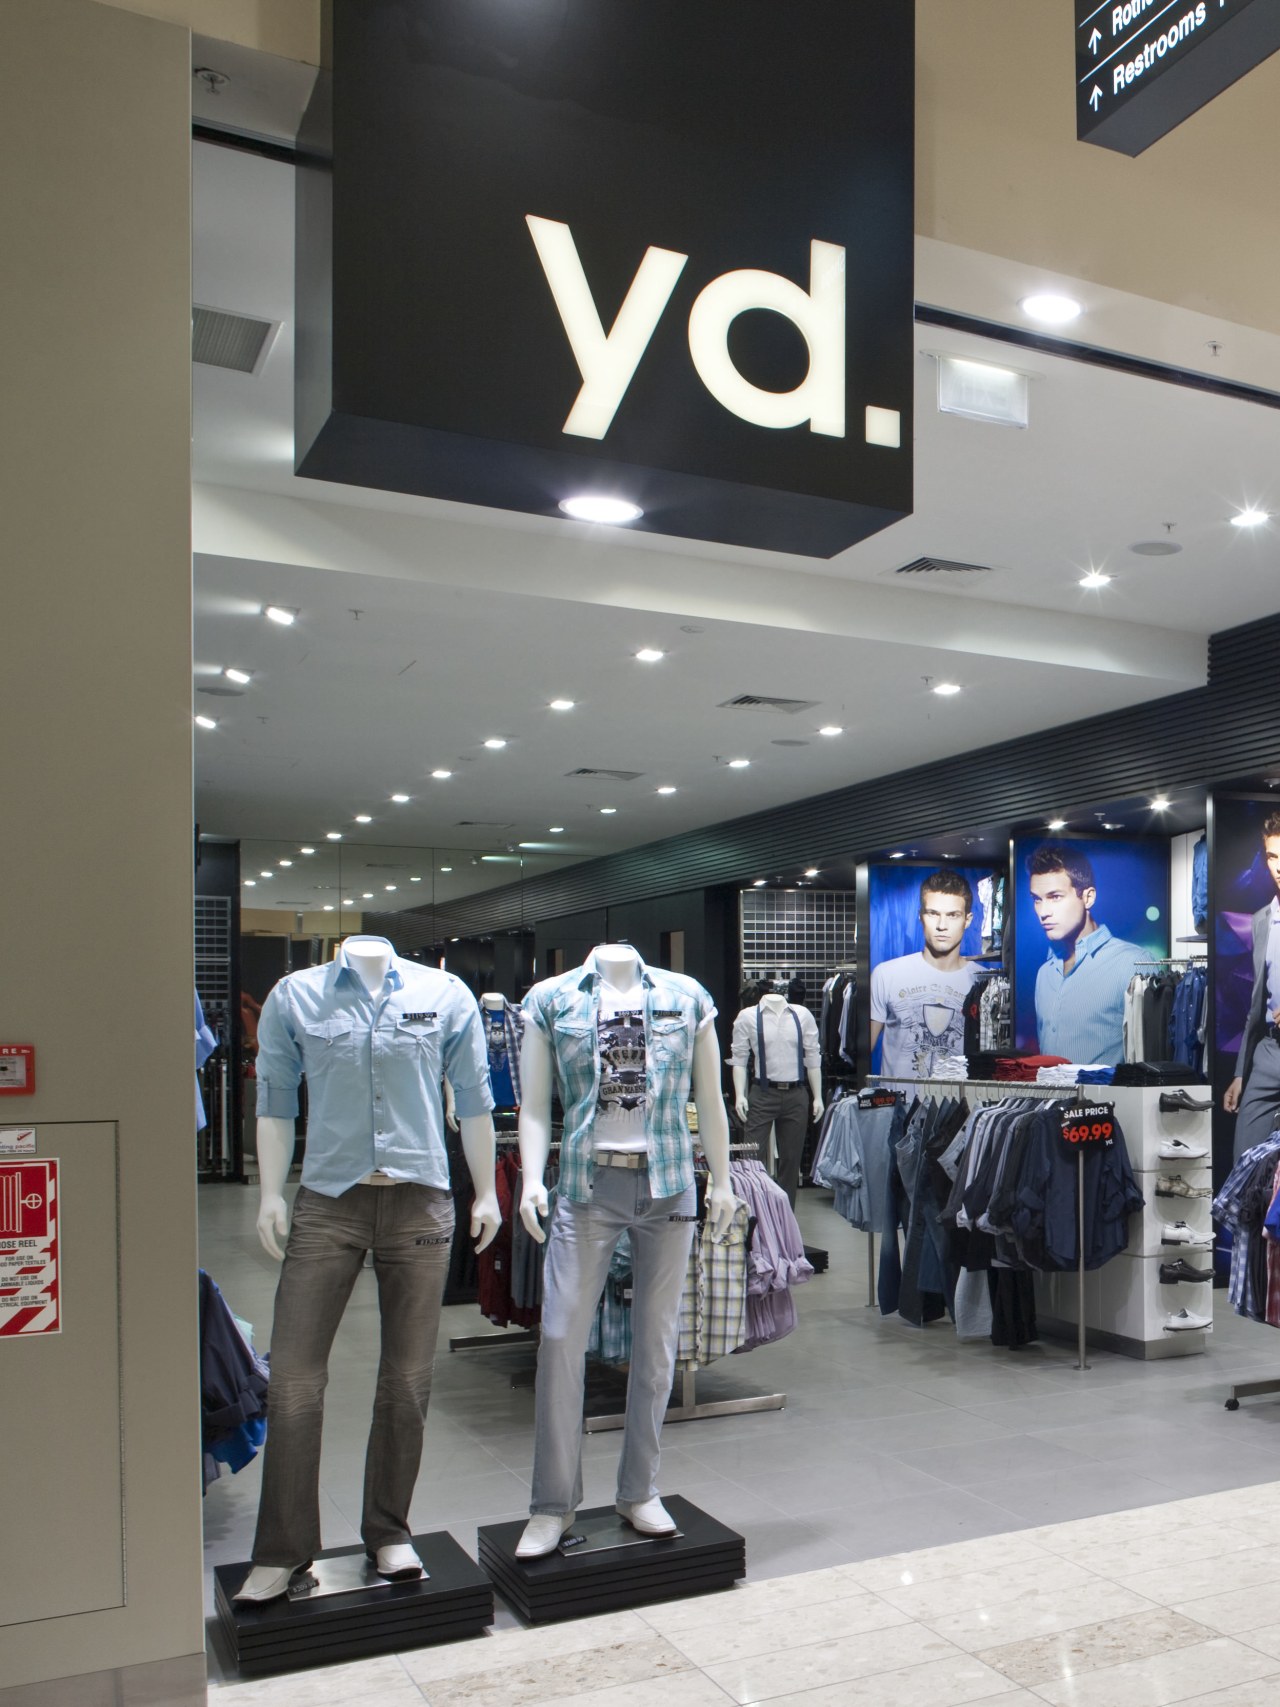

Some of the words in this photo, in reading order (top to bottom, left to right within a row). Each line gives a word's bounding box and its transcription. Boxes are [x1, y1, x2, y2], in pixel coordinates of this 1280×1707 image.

[1113, 2, 1206, 95] Restrooms
[524, 214, 901, 447] yd.
[1063, 1109, 1084, 1119] SALE
[1085, 1106, 1109, 1117] PRICE
[1062, 1122, 1113, 1143] $69.99
[18, 1239, 38, 1248] REEL
